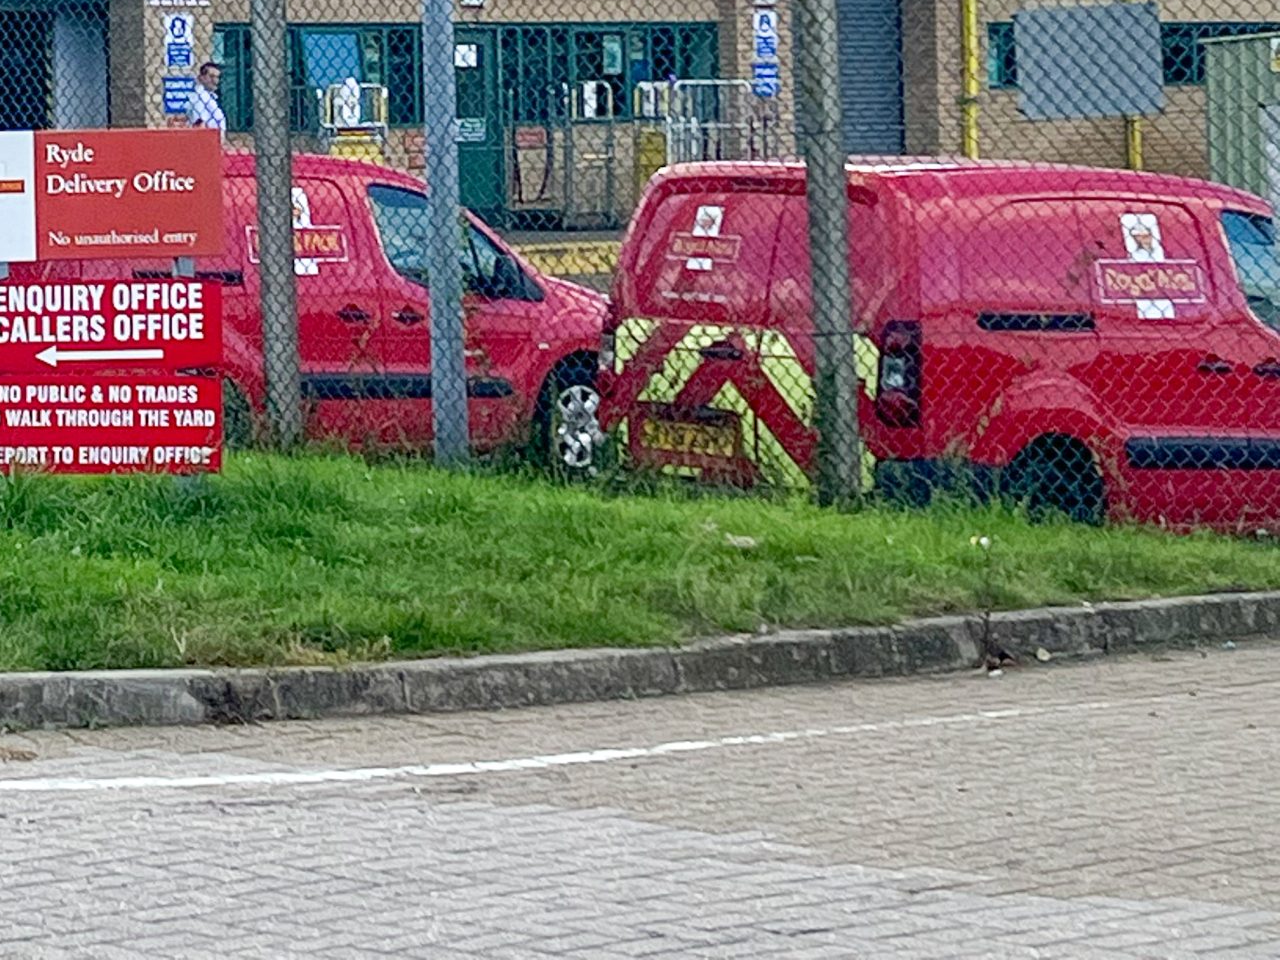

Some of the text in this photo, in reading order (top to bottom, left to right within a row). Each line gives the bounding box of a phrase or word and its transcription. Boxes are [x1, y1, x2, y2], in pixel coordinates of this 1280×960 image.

[46, 142, 94, 169] Ryde
[46, 170, 195, 198] Delivery Office
[48, 228, 197, 246] No unauthorised entry
[112, 283, 203, 311] OFFICE
[113, 313, 204, 341] OFFICE
[26, 385, 86, 403] PUBLIC
[91, 385, 103, 403] &
[109, 385, 131, 403] NO
[135, 385, 198, 403] TRADES
[5, 409, 51, 427] WALK
[55, 409, 133, 427] THROUGH
[138, 409, 169, 427] THE
[173, 409, 215, 427] YARD
[52, 446, 73, 464] TO
[79, 446, 149, 465] ENQUIRY
[153, 446, 212, 464] OFFICE
